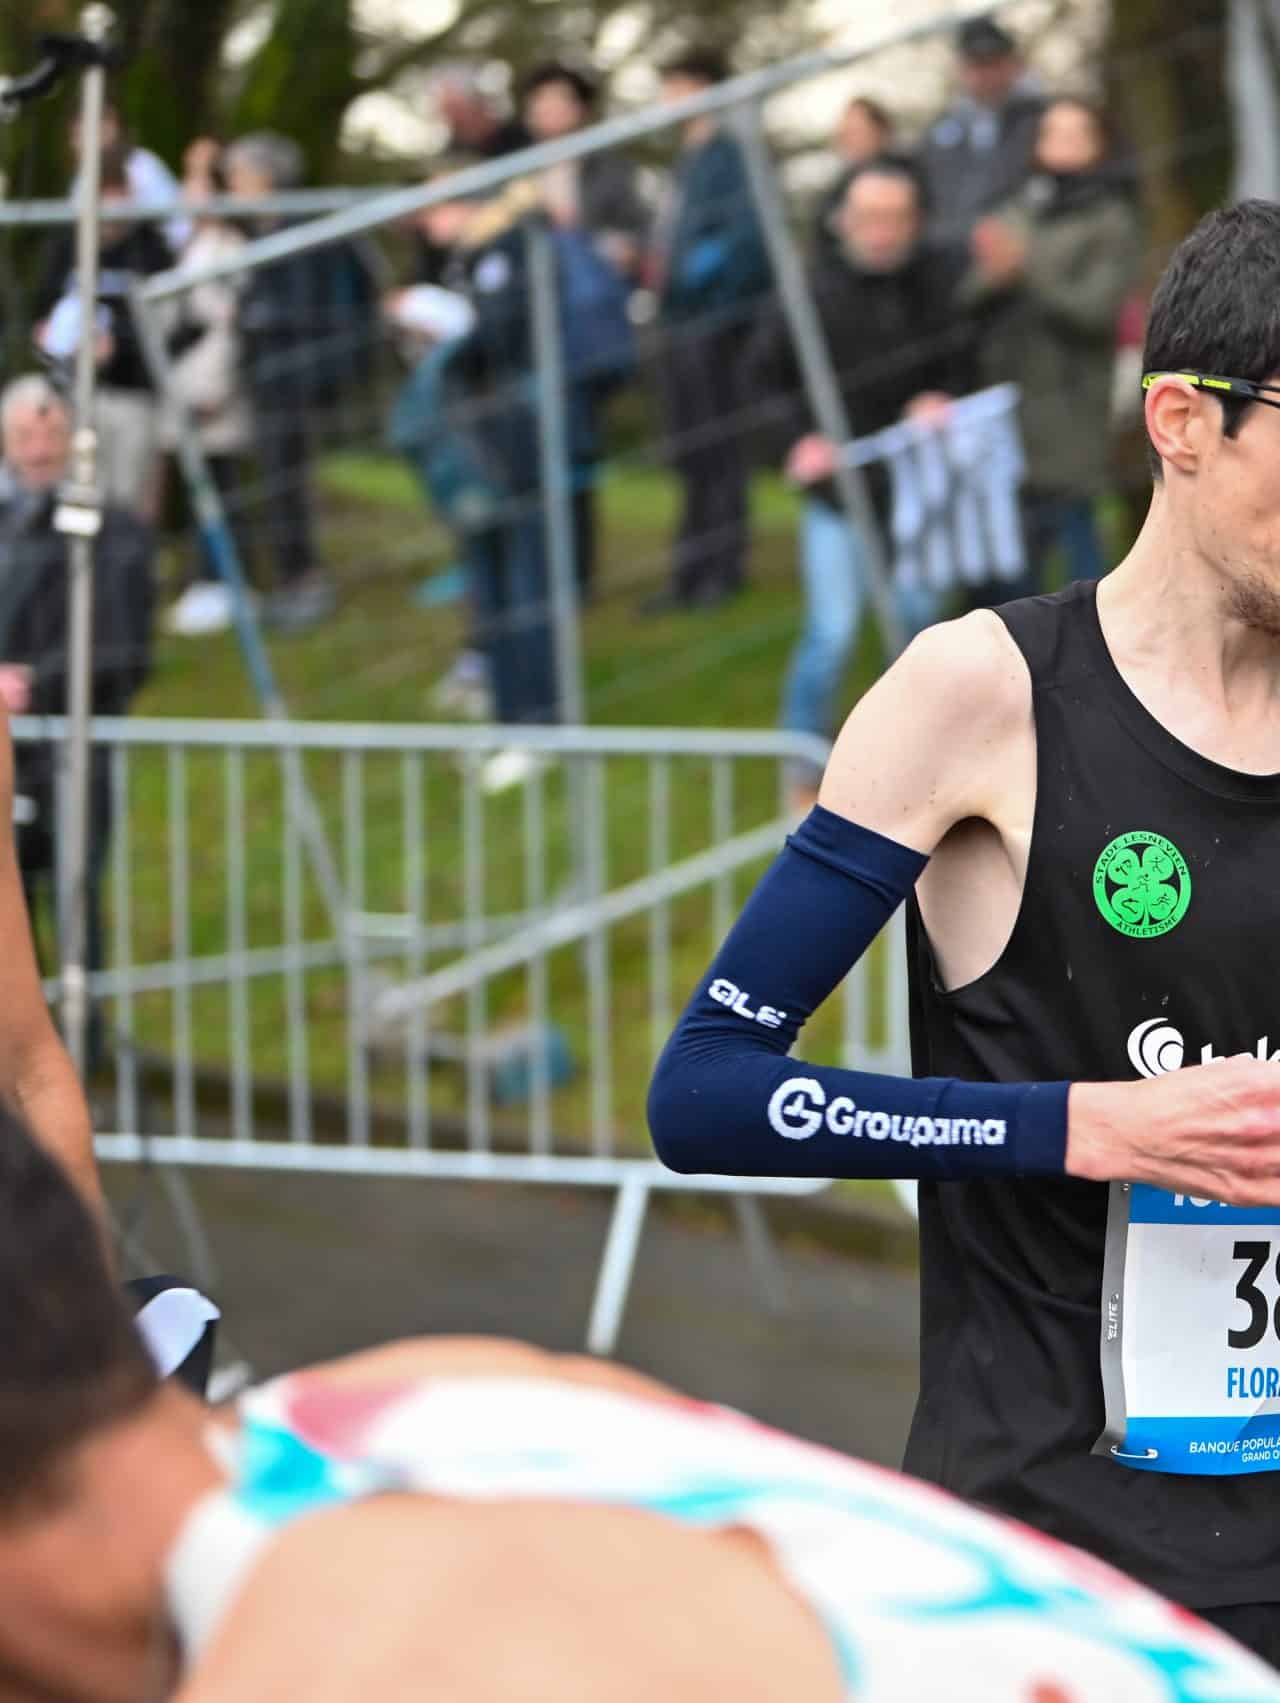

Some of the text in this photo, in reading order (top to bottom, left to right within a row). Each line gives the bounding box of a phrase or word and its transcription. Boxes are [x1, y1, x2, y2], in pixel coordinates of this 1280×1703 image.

[1117, 915, 1179, 937] ATHLETISME
[826, 1097, 1007, 1146] Groupama
[1189, 1440, 1241, 1454] BANQUE
[1241, 1450, 1271, 1463] GRAND
